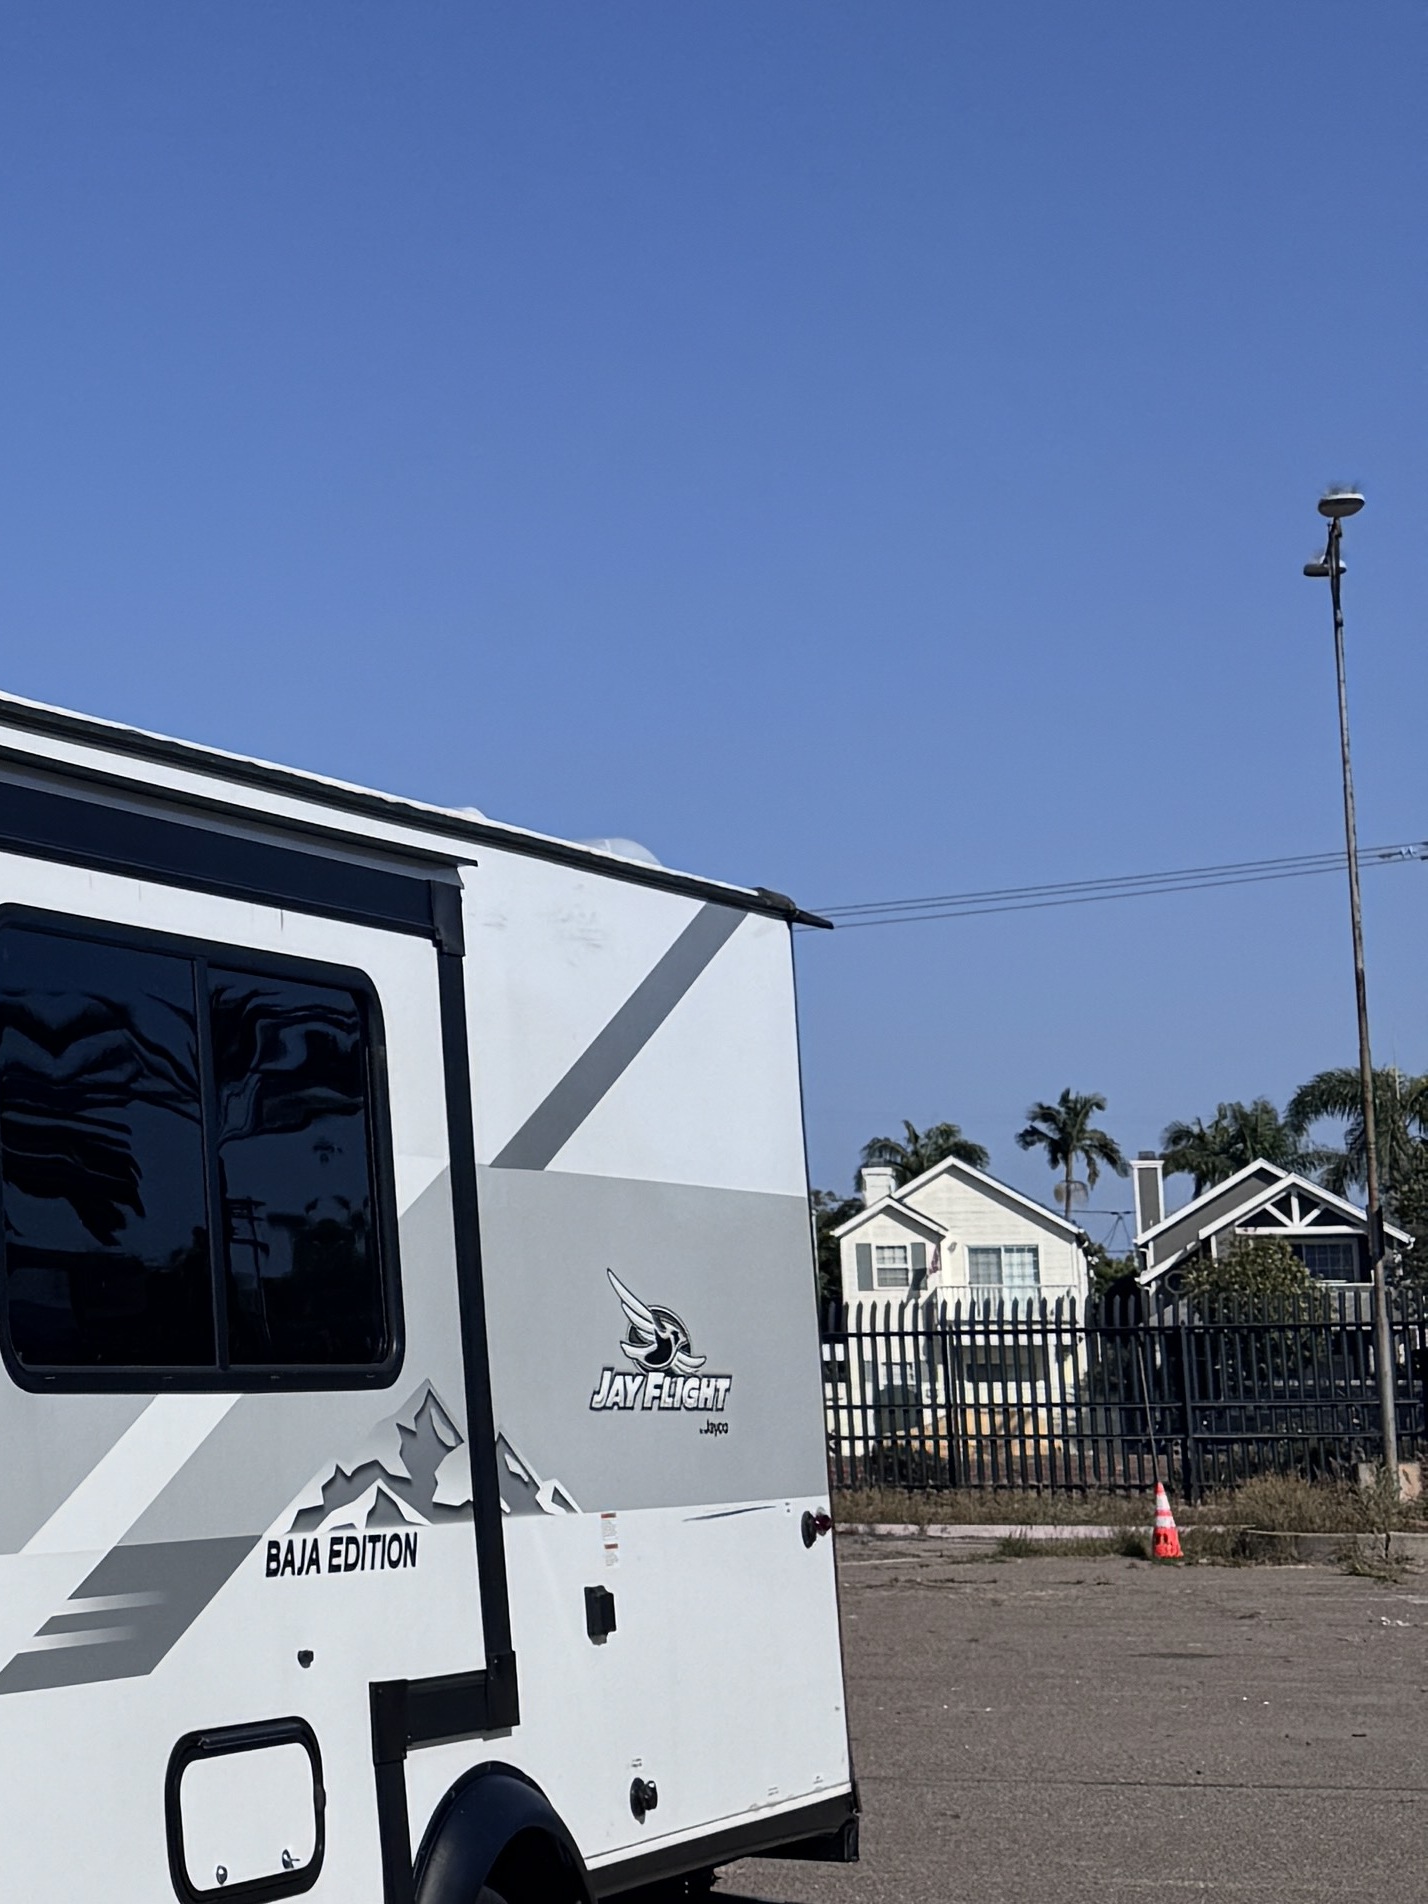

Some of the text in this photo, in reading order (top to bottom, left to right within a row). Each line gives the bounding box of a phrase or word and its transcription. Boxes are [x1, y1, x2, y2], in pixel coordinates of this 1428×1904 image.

[589, 1366, 733, 1411] JAY FLIGHT
[265, 1531, 418, 1578] BAJA EDITION
